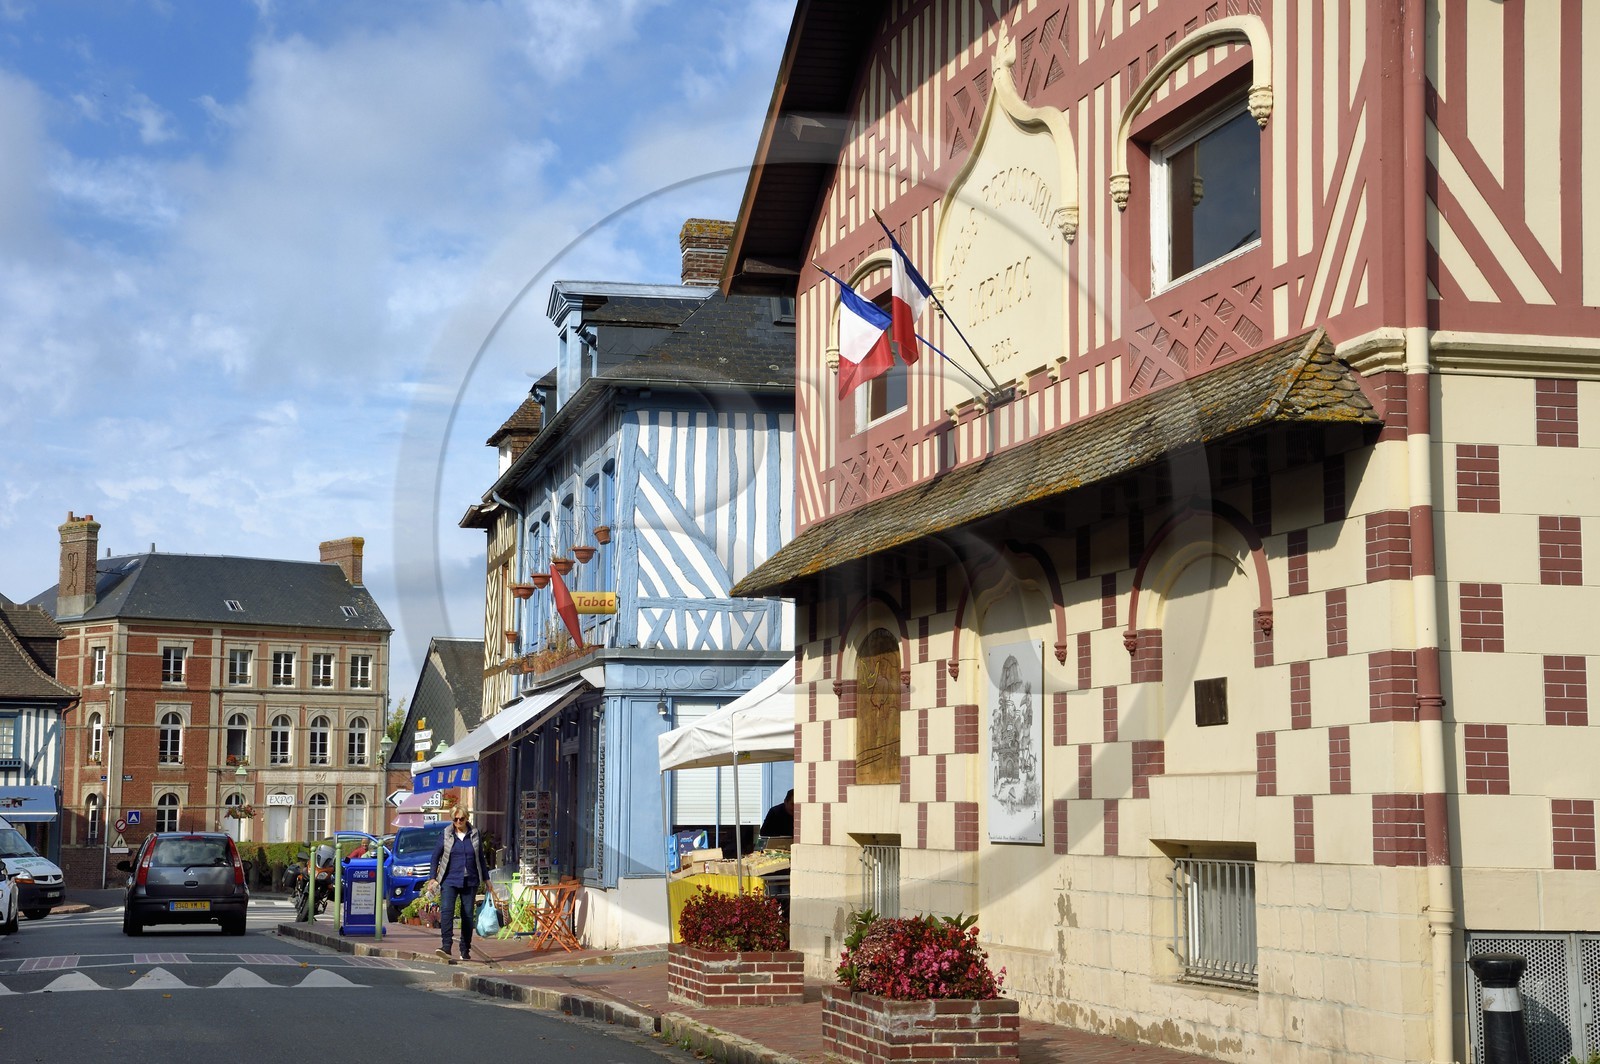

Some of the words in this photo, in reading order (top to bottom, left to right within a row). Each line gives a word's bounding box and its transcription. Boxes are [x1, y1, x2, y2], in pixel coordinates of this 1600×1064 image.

[968, 256, 1032, 328] LAPLACE
[576, 596, 614, 607] Tabac
[269, 795, 293, 804] EXPO
